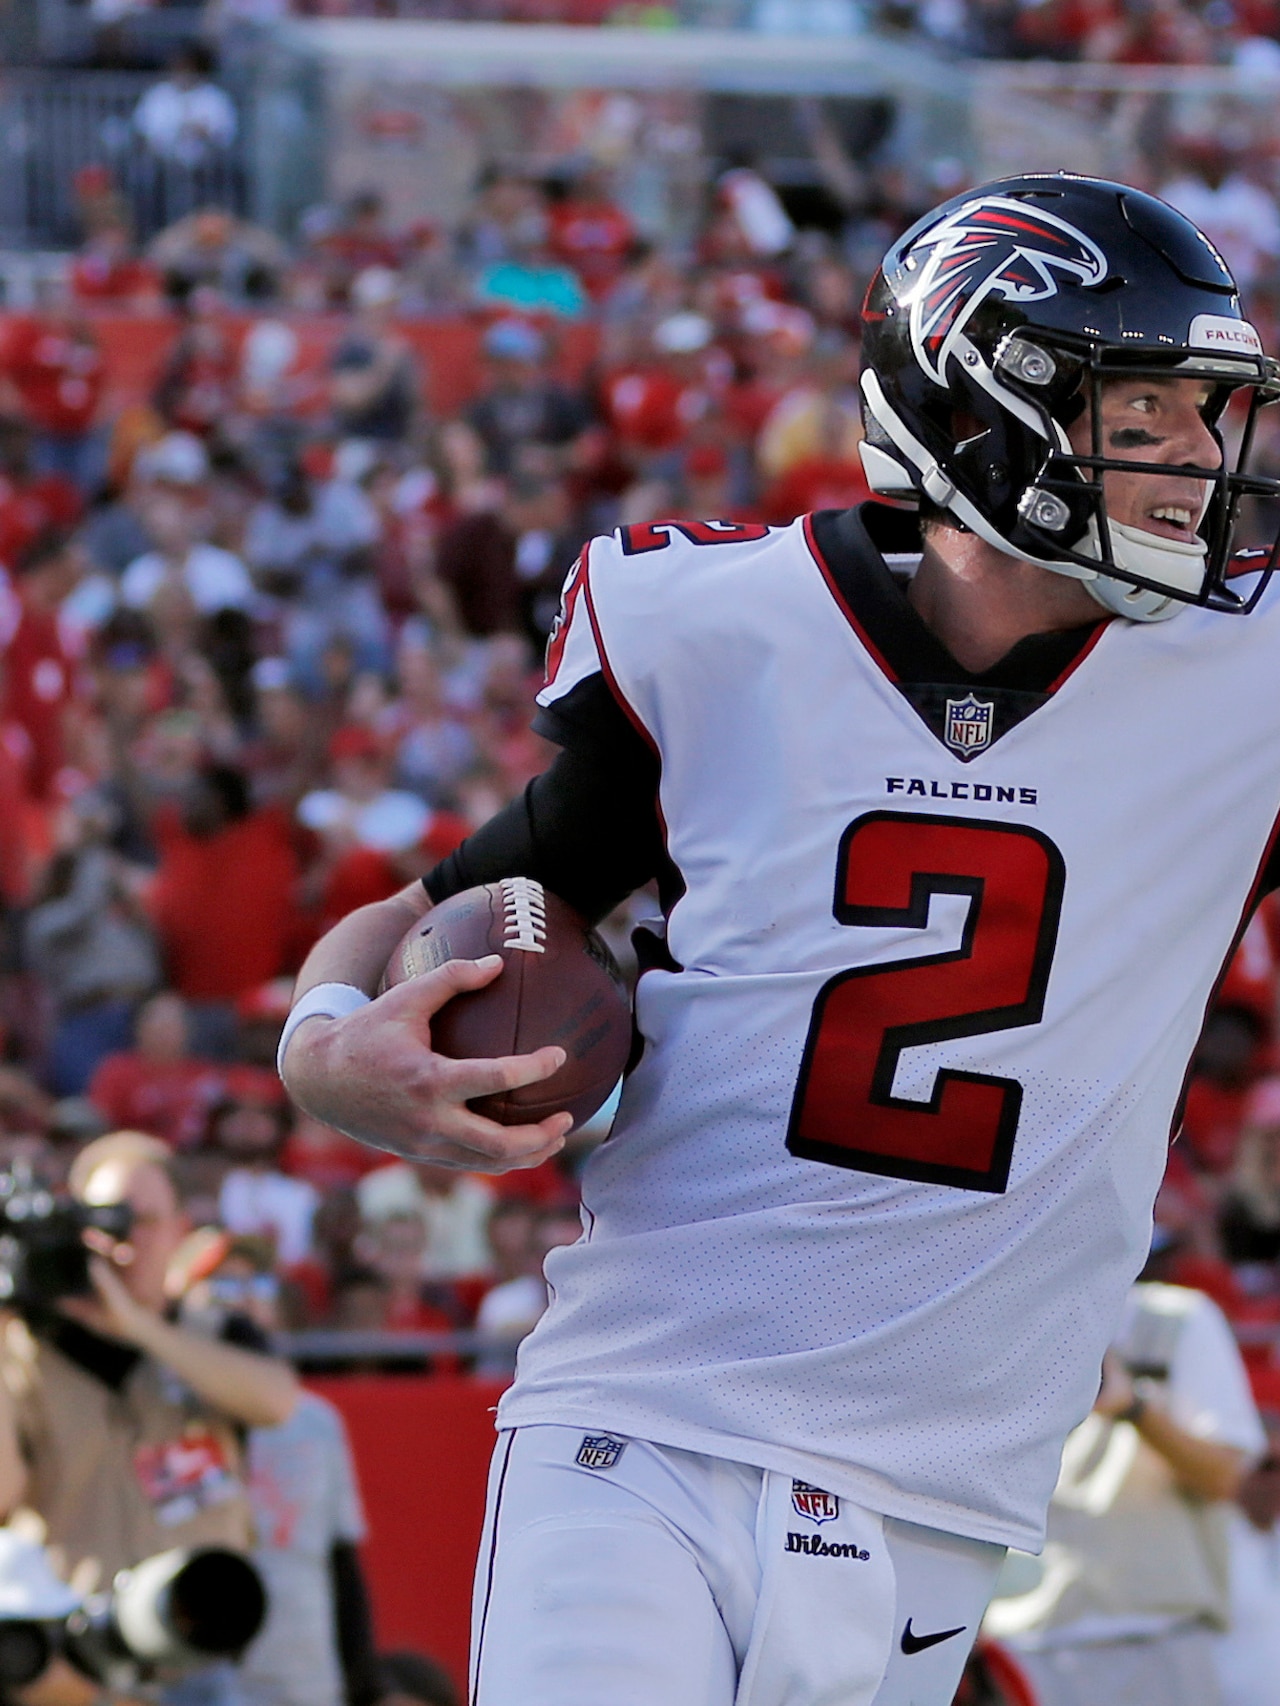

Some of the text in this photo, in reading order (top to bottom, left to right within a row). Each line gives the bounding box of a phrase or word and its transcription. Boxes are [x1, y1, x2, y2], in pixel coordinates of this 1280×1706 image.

[952, 722, 984, 745] NFL
[885, 777, 1038, 805] FALCONS
[785, 809, 1067, 1194] 2
[580, 1448, 611, 1466] NFL
[794, 1493, 835, 1518] NFL
